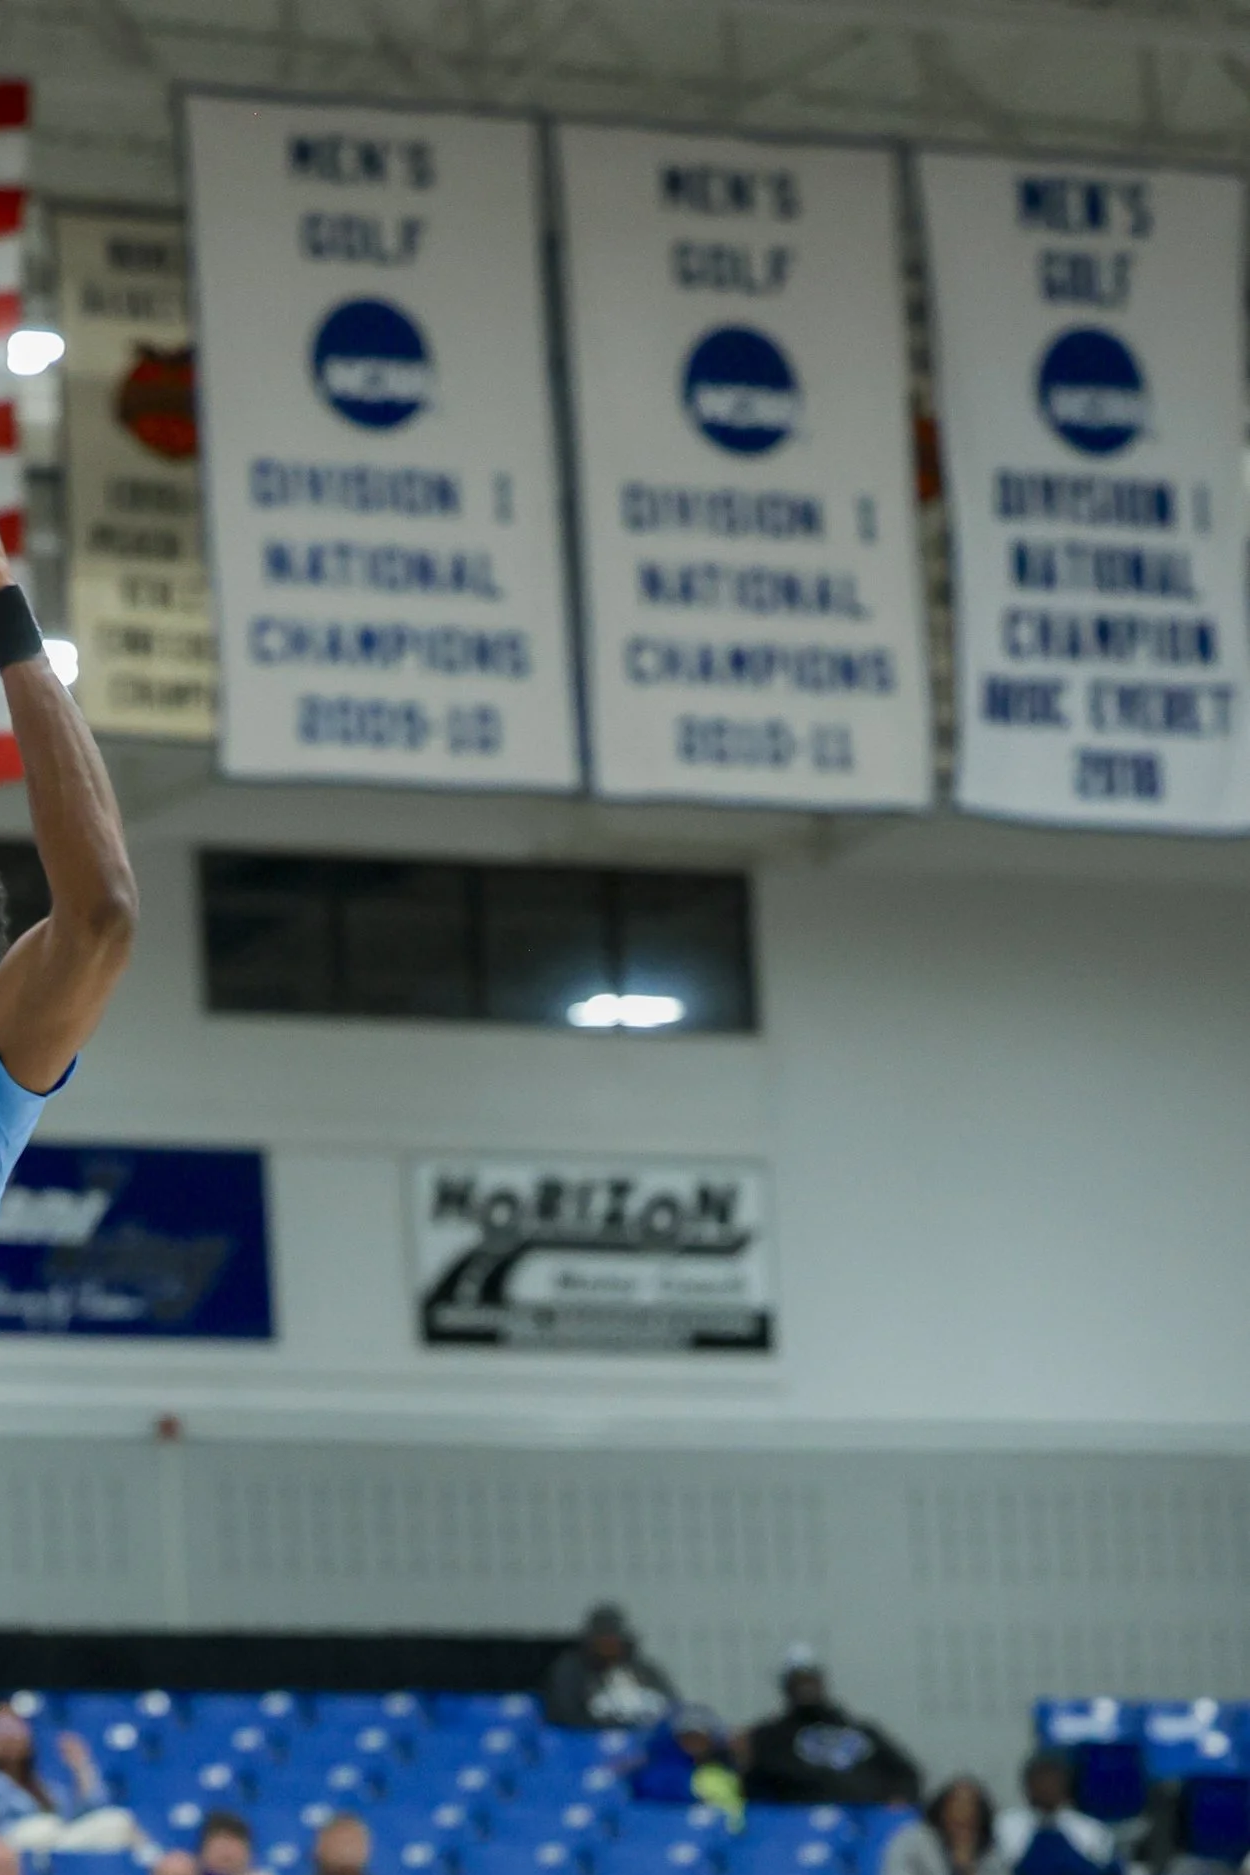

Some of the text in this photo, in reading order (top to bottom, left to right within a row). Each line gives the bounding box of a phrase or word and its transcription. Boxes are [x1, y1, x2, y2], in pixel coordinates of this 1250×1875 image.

[300, 211, 427, 266] GOLF
[672, 238, 792, 296] GOLF
[251, 457, 460, 517] DIVISION
[620, 480, 825, 541] DIVISION
[263, 538, 502, 602] NATIONAL
[635, 560, 874, 623] NATIONAL
[250, 612, 532, 680] CHAMPIONS
[623, 634, 898, 697] CHAMPIONS
[433, 1171, 742, 1238] HORIZON
